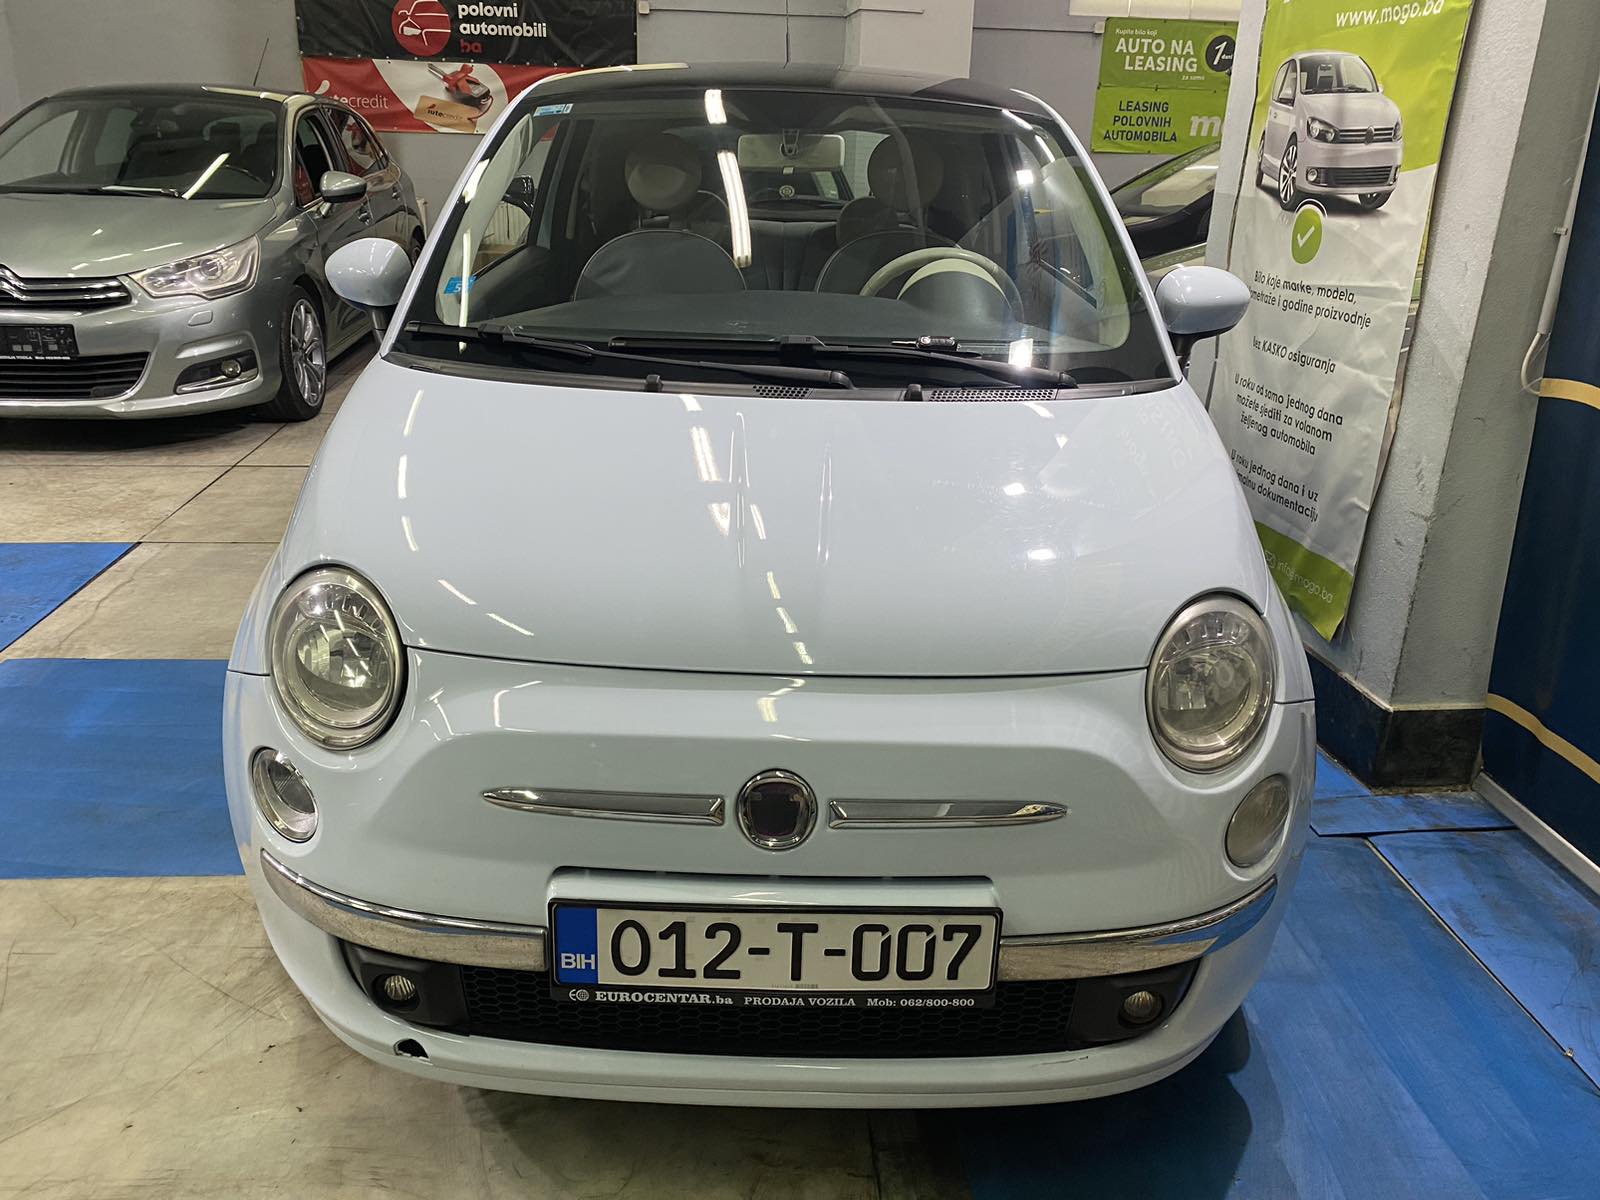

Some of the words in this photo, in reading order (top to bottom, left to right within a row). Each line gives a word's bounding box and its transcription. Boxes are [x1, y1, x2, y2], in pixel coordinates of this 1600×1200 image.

[458, 2, 518, 19] polovni
[1336, 0, 1444, 27] www.mogo.ba
[459, 22, 547, 37] automobili
[1115, 38, 1165, 54] AUTO
[1171, 40, 1195, 55] NA
[1213, 41, 1227, 65] 1
[1124, 56, 1198, 72] LEASING
[1119, 101, 1169, 112] LEASING
[1113, 116, 1171, 127] POLOVNIH
[1189, 115, 1223, 136] m
[1104, 130, 1177, 142] AUTOMOBILA
[1266, 273, 1281, 290] koje
[1282, 280, 1315, 296] marke,
[1317, 286, 1356, 305] modela,
[1277, 295, 1281, 307] i
[1282, 299, 1313, 314] godine
[1315, 306, 1371, 329] proizvodnje
[1262, 340, 1287, 358] KASKO
[1288, 351, 1336, 374] osiguranja
[1240, 377, 1254, 391] roku
[1256, 385, 1264, 396] od
[1265, 389, 1284, 404] samo
[1286, 394, 1315, 418] jednog
[1317, 407, 1343, 425] dana
[1236, 394, 1259, 412] možete
[1260, 403, 1281, 421] sjediti
[1283, 414, 1293, 426] za
[1295, 420, 1333, 442] volanom
[1240, 411, 1267, 437] željenog
[1270, 428, 1316, 455] automobila
[1249, 460, 1276, 485] jednog
[1278, 474, 1300, 495] dana
[1302, 485, 1306, 497] i
[1308, 489, 1319, 502] uz
[1257, 483, 1319, 522] dokumentaciju
[560, 953, 596, 969] BIH
[610, 919, 982, 982] 012-T-007
[595, 991, 733, 1005] EUROCENTAR.ba
[743, 996, 805, 1007] PRODAJA
[809, 997, 856, 1007] VOZILA
[867, 998, 897, 1007] Mob:
[900, 998, 975, 1007] 062/800-800
